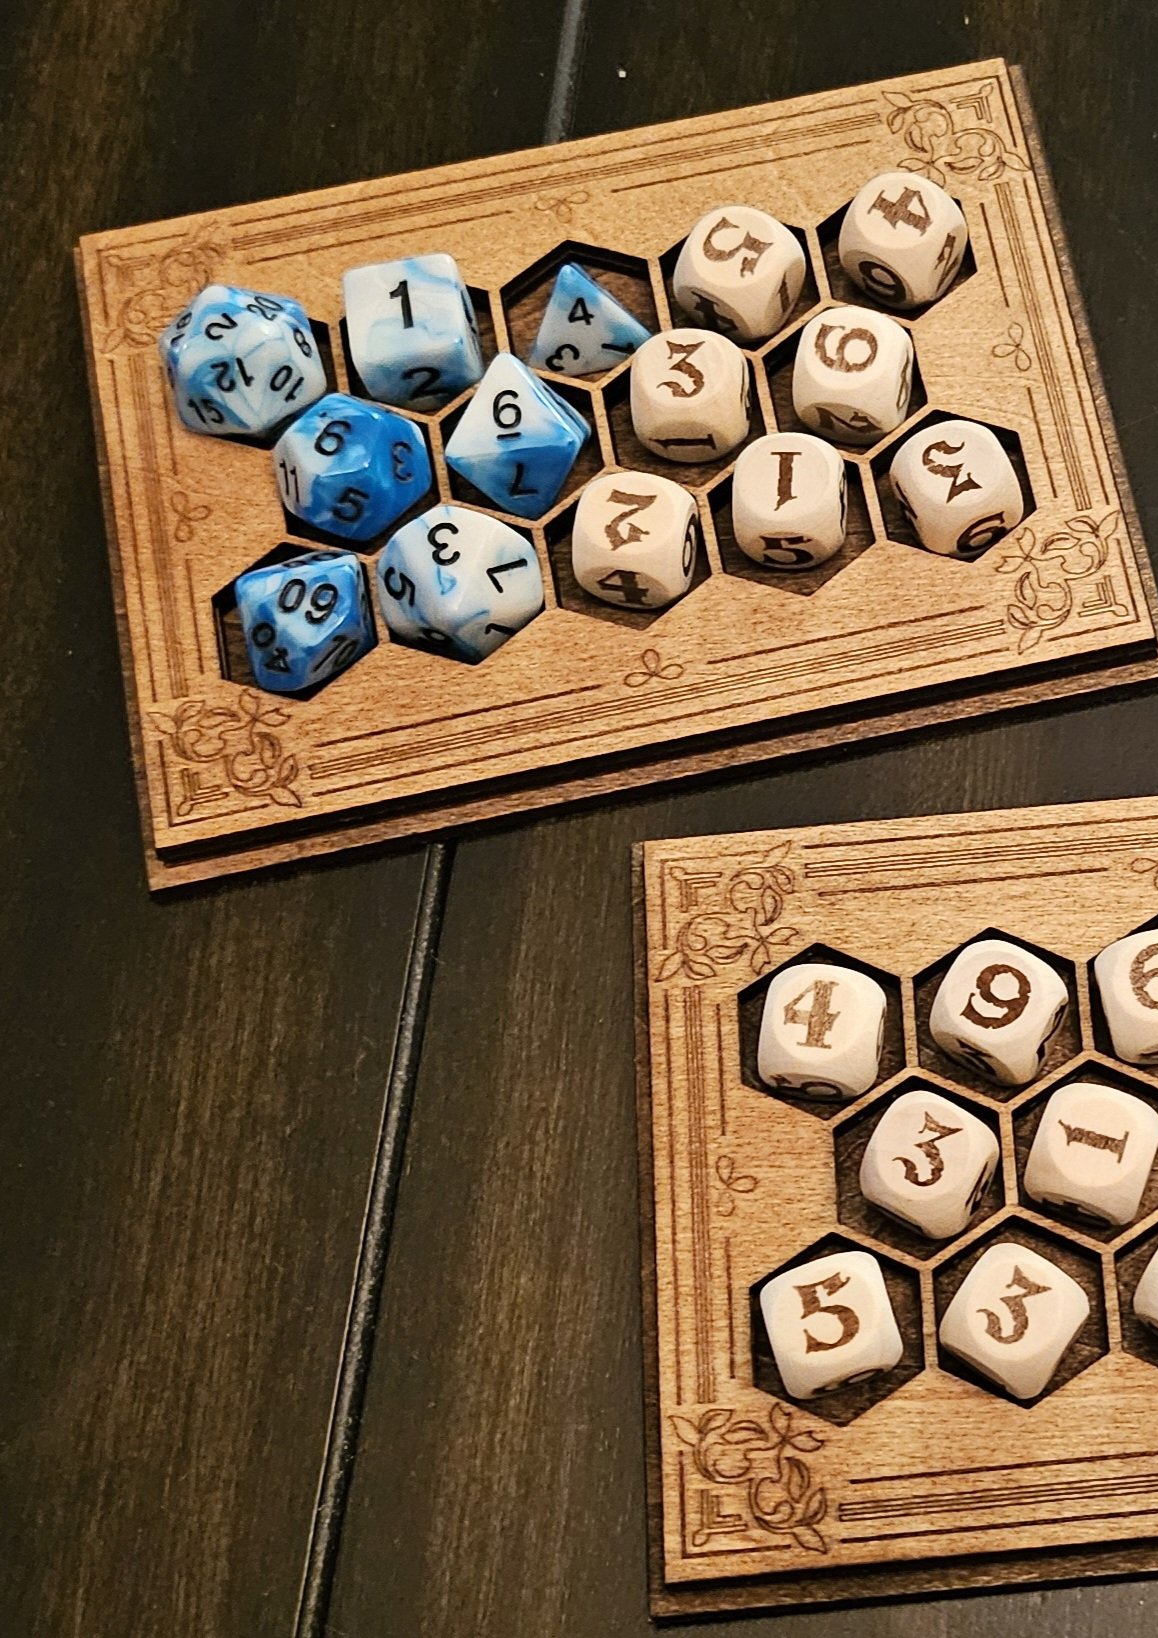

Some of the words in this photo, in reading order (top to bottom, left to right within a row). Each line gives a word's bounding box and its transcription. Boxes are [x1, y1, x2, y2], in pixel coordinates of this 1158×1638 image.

[867, 186, 933, 236] 4
[703, 217, 774, 278] 5
[205, 313, 239, 341] 2
[246, 296, 283, 321] 20
[389, 280, 414, 329] 1
[567, 297, 594, 325] 4
[293, 328, 312, 359] 8
[545, 343, 580, 371] 3
[401, 367, 450, 398] 2
[657, 340, 706, 398] 3
[492, 389, 522, 440] 6
[279, 459, 300, 504] 11
[392, 440, 413, 482] 3
[922, 440, 983, 504] 3
[331, 487, 370, 523] 5
[603, 488, 658, 551] 2
[427, 522, 461, 566] 3
[384, 566, 416, 607] 5
[783, 979, 842, 1050] 4
[891, 1110, 964, 1187] 3
[792, 1271, 861, 1355] 5
[975, 1264, 1053, 1345] 3
